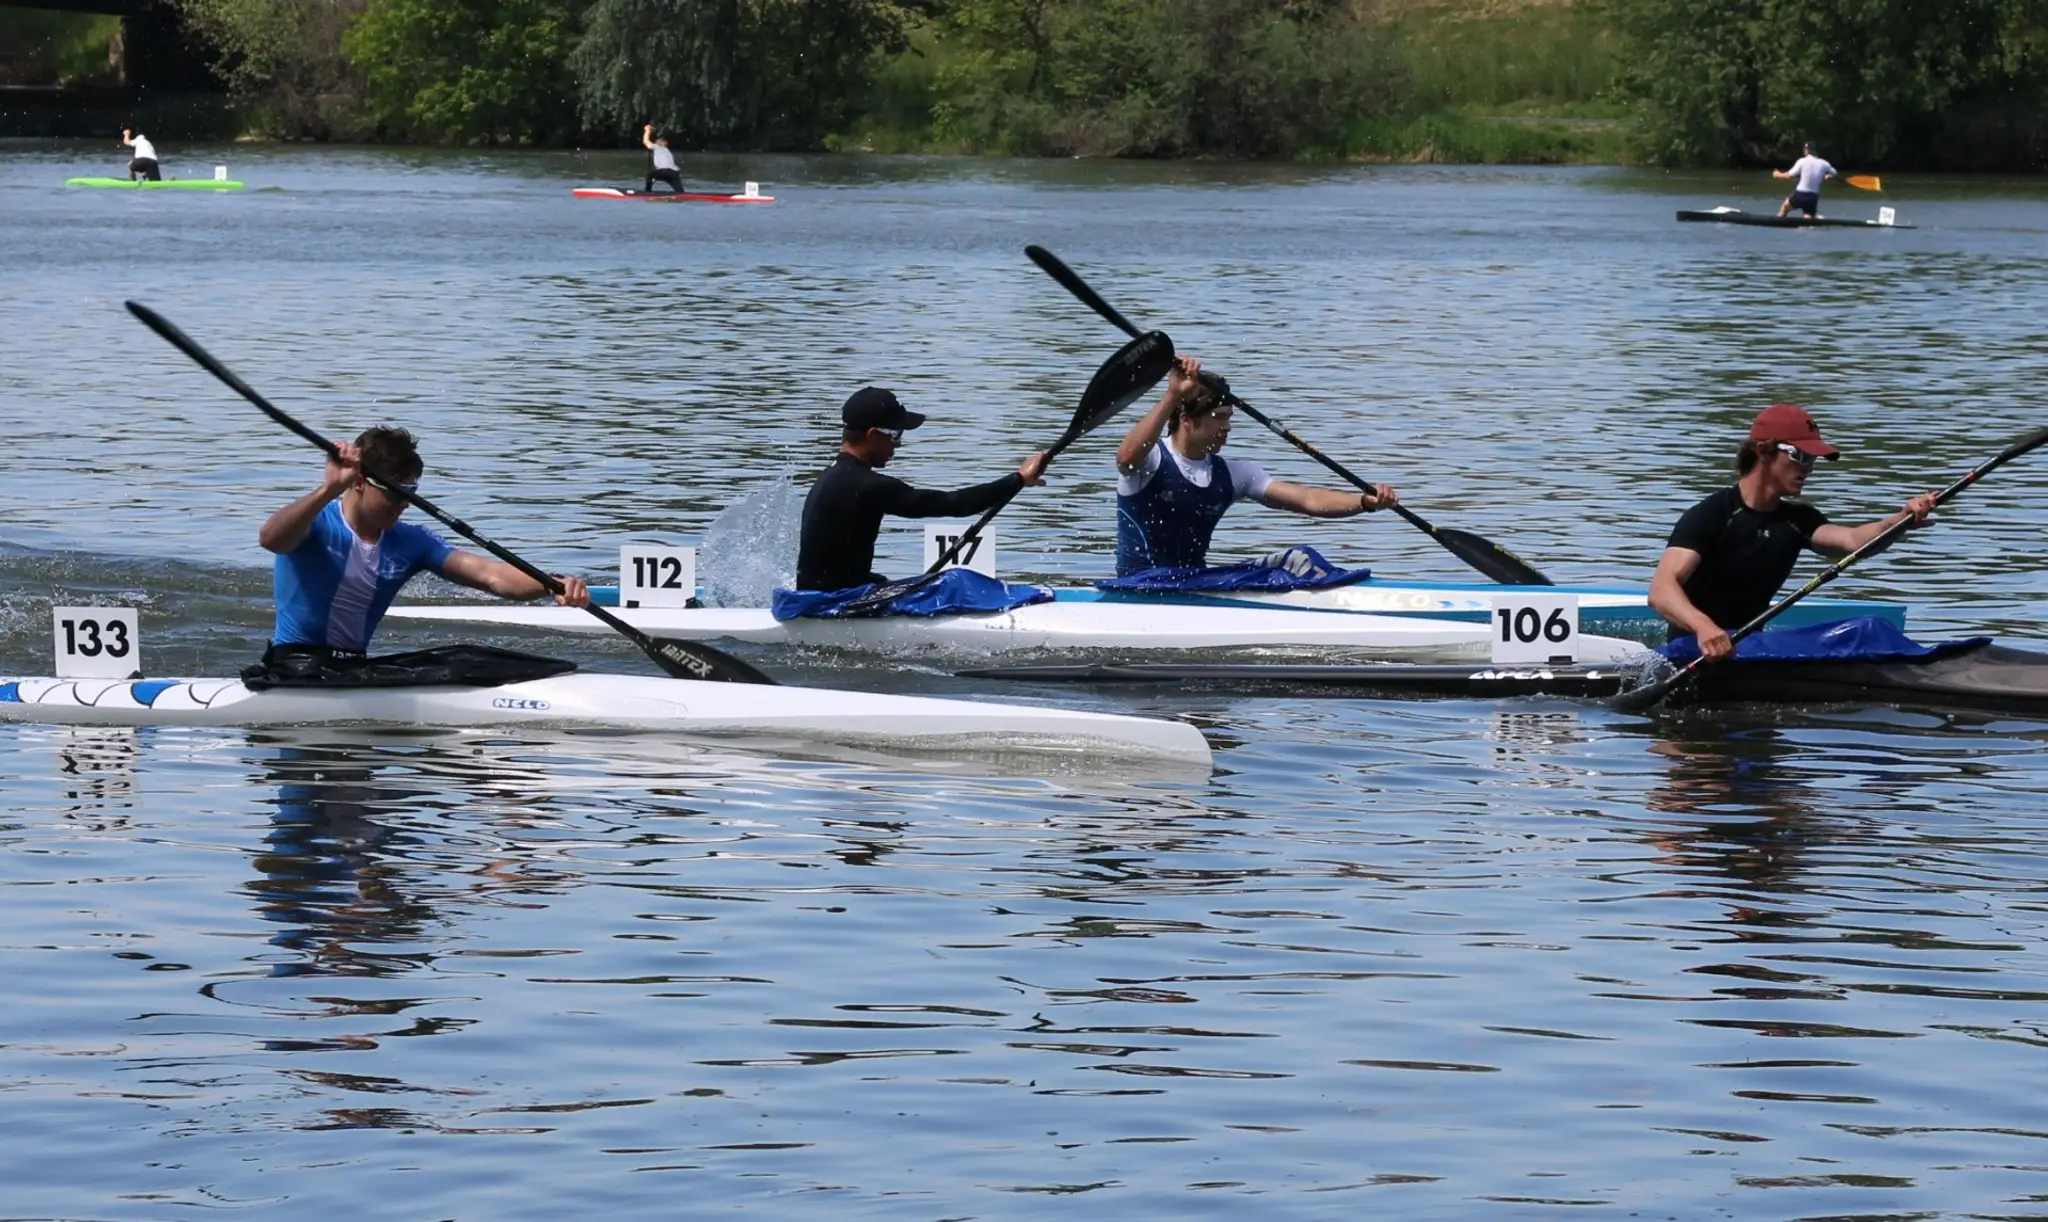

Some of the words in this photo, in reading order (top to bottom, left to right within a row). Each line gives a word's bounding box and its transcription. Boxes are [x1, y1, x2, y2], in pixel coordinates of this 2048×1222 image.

[935, 535, 983, 565] 117
[632, 556, 682, 589] 112
[62, 619, 130, 658] 133
[1497, 607, 1571, 643] 106
[494, 698, 551, 711] NELO
